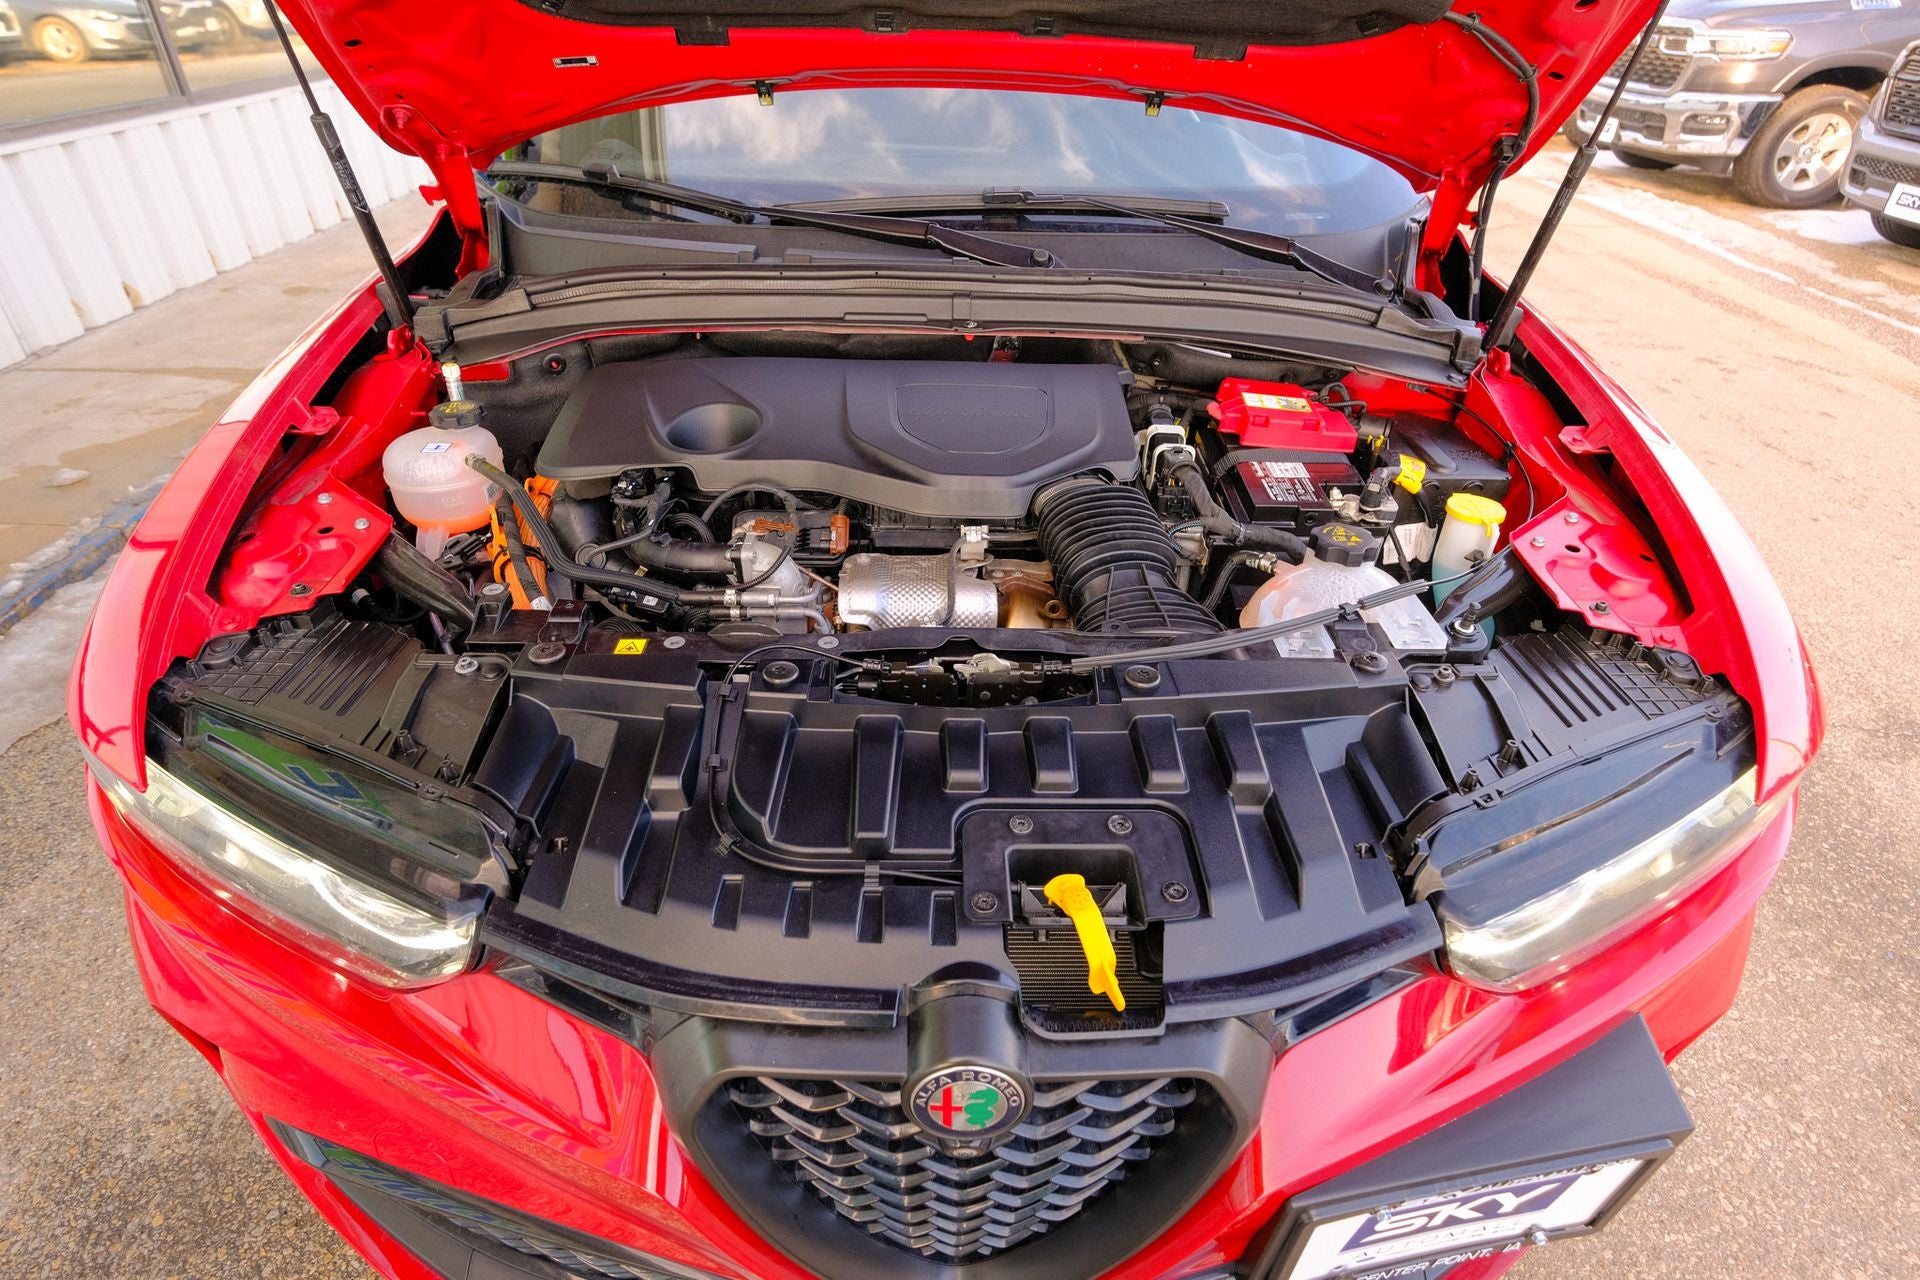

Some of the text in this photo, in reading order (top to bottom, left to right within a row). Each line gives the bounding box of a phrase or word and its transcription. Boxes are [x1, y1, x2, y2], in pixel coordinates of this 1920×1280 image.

[915, 1071, 1021, 1108] ALFA ROMEO
[1360, 1183, 1562, 1243] SKY
[1502, 1241, 1522, 1253] IA
